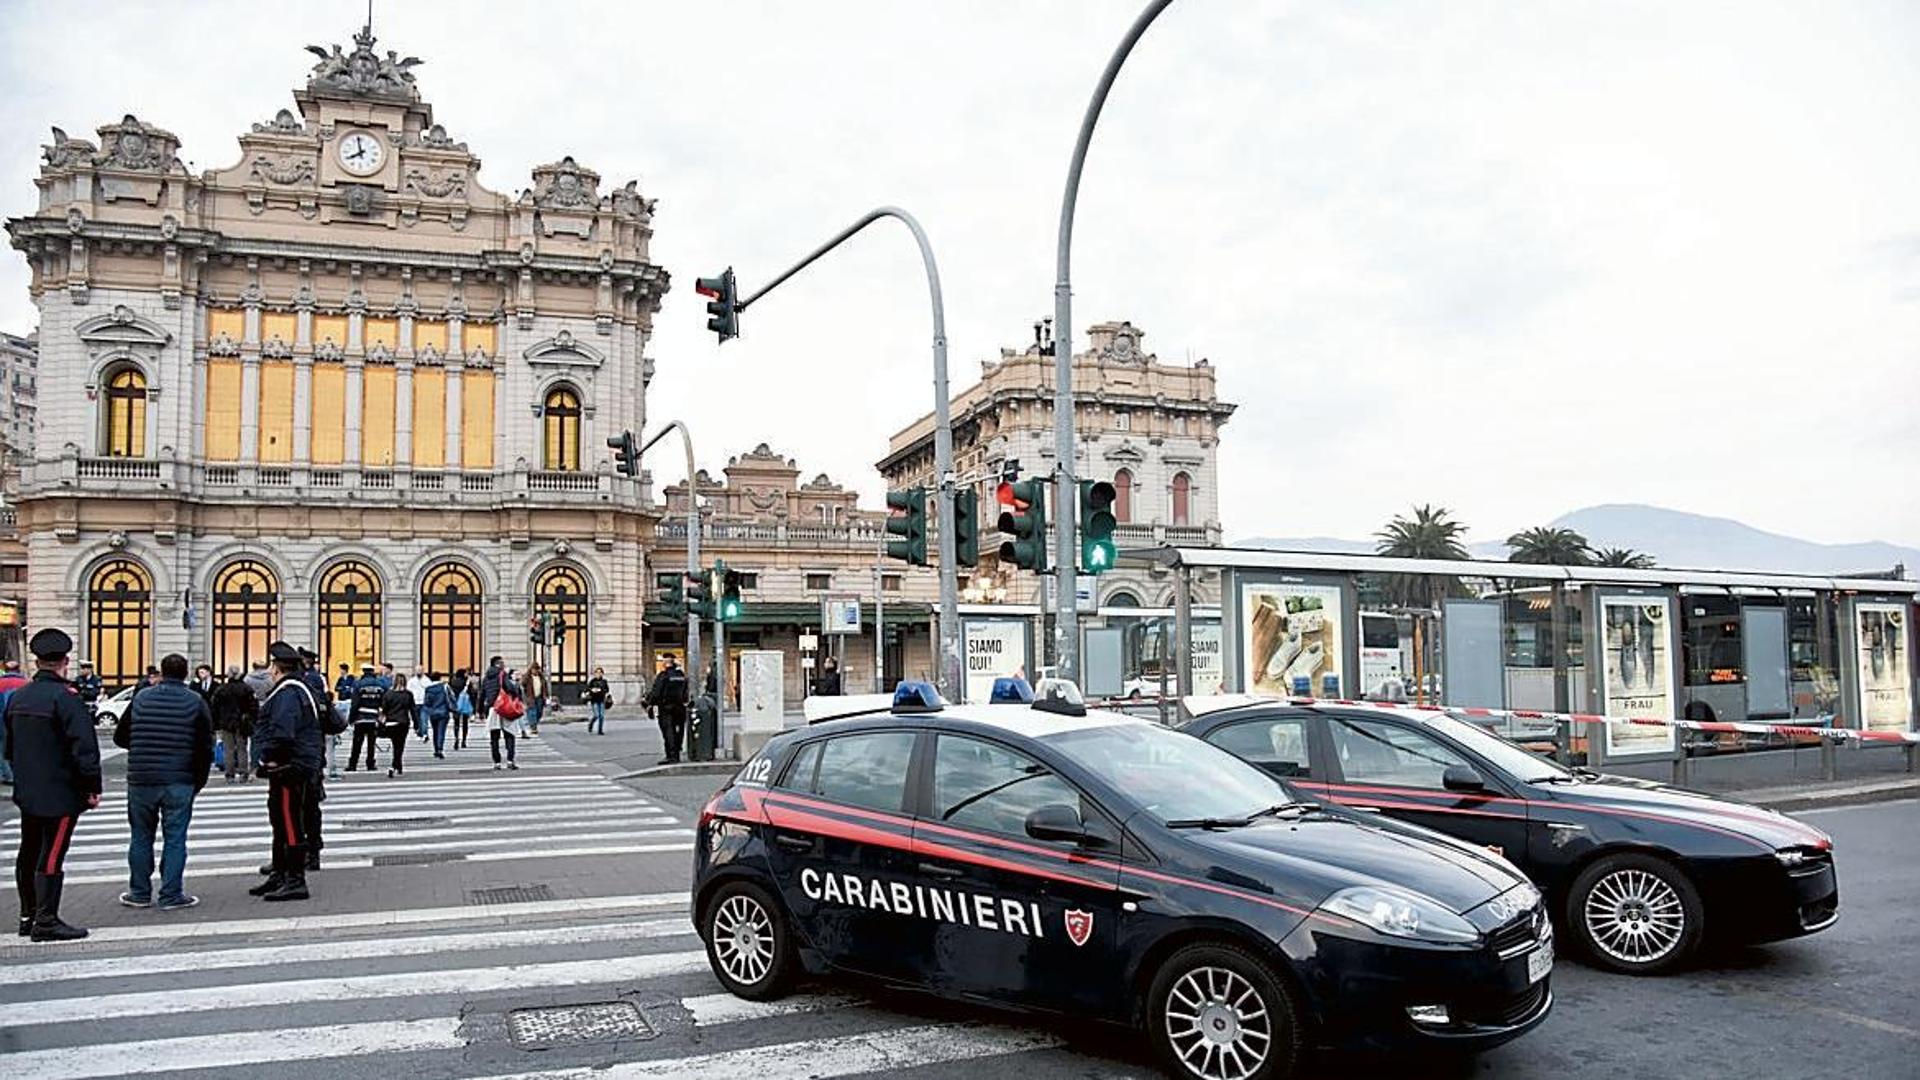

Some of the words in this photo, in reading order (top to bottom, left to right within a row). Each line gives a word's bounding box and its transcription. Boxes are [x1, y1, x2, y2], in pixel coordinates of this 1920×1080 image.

[969, 639, 1002, 654] SIAMO
[969, 656, 992, 670] QUI!
[1624, 700, 1653, 709] FRAU
[746, 758, 772, 780] 112
[800, 867, 1044, 938] CARABINIERI
